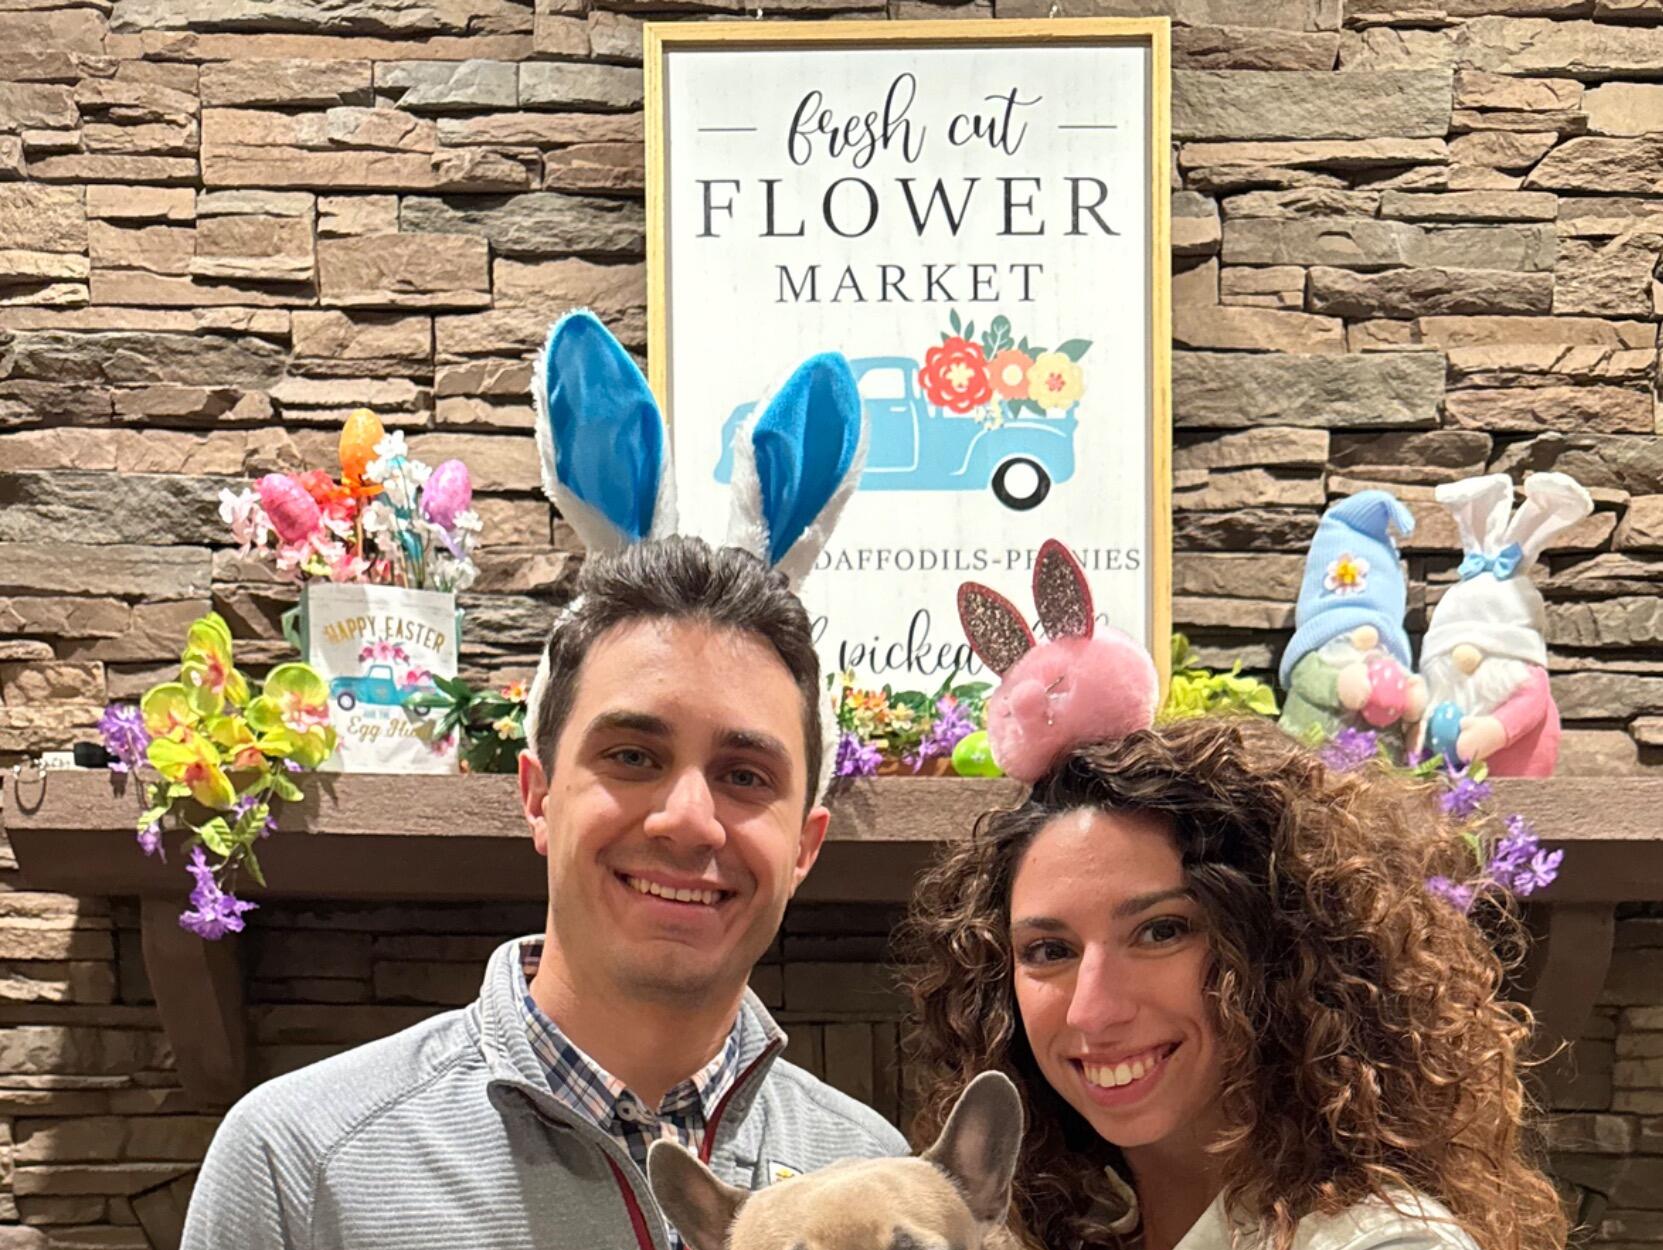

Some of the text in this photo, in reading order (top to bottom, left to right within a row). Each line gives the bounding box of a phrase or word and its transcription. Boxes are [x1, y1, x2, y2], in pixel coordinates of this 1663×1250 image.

[787, 72, 1043, 168] fresh cut
[695, 176, 1121, 239] FLOWER
[775, 263, 1044, 303] MARKET
[815, 548, 1141, 571] DAFFODILS-PNIES
[323, 615, 446, 653] HAPPY EASTER
[347, 715, 381, 743] Egg
